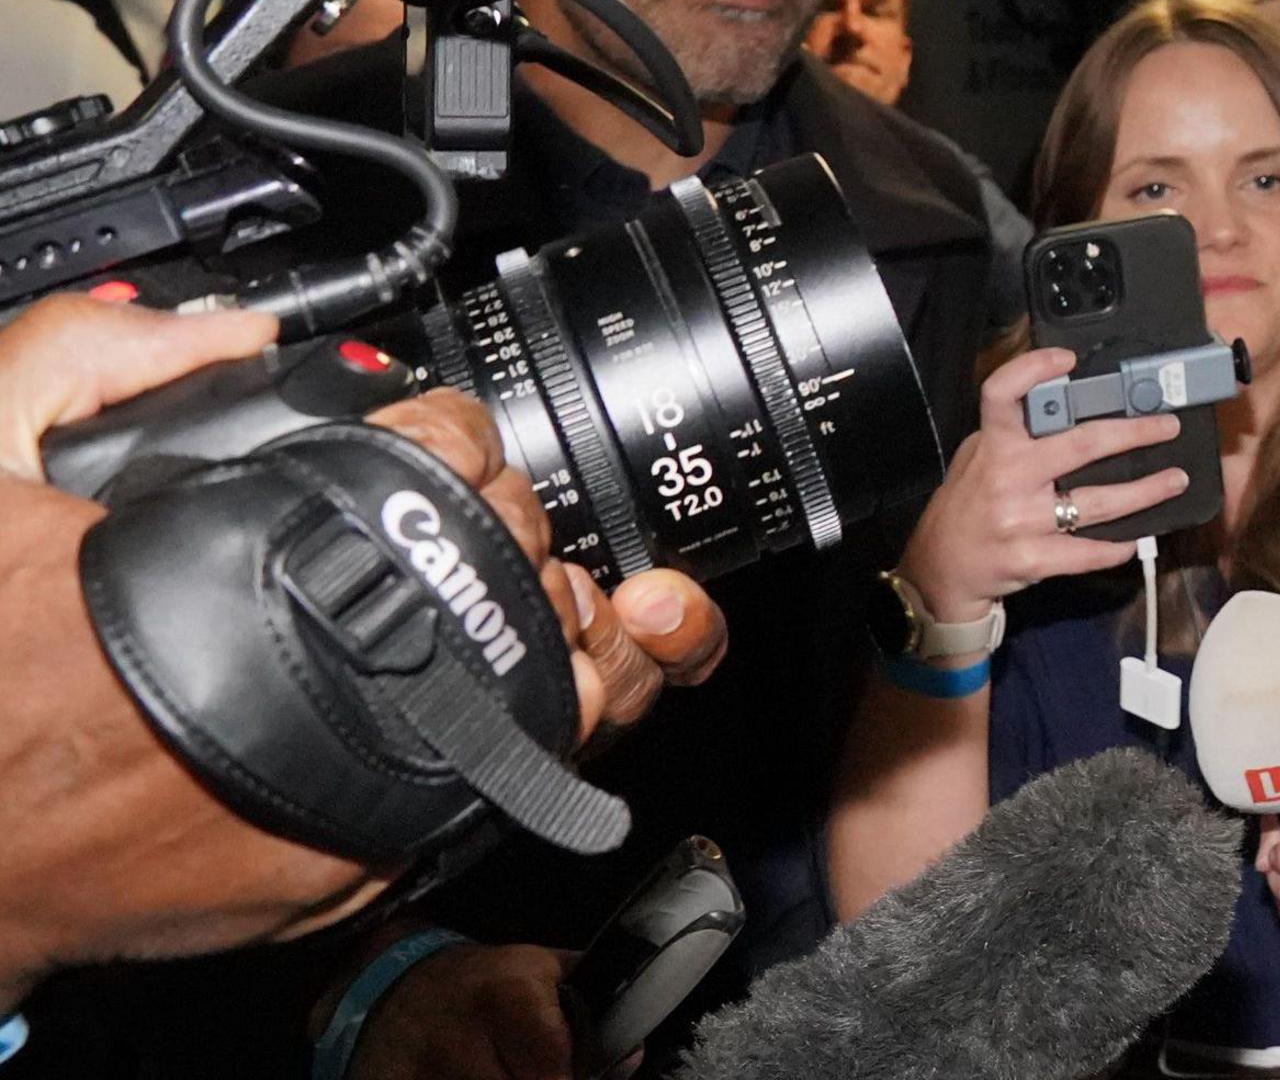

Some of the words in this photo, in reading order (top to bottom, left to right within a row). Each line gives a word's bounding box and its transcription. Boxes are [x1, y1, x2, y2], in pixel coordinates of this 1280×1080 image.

[499, 342, 522, 362] 30
[508, 359, 529, 379] 31
[513, 378, 538, 398] 32
[637, 388, 685, 436] 18
[550, 469, 572, 488] 18
[651, 444, 713, 497] 35
[558, 489, 579, 508] 19
[665, 486, 723, 522] T2.0
[577, 532, 599, 551] 20
[381, 490, 527, 677] Canon
